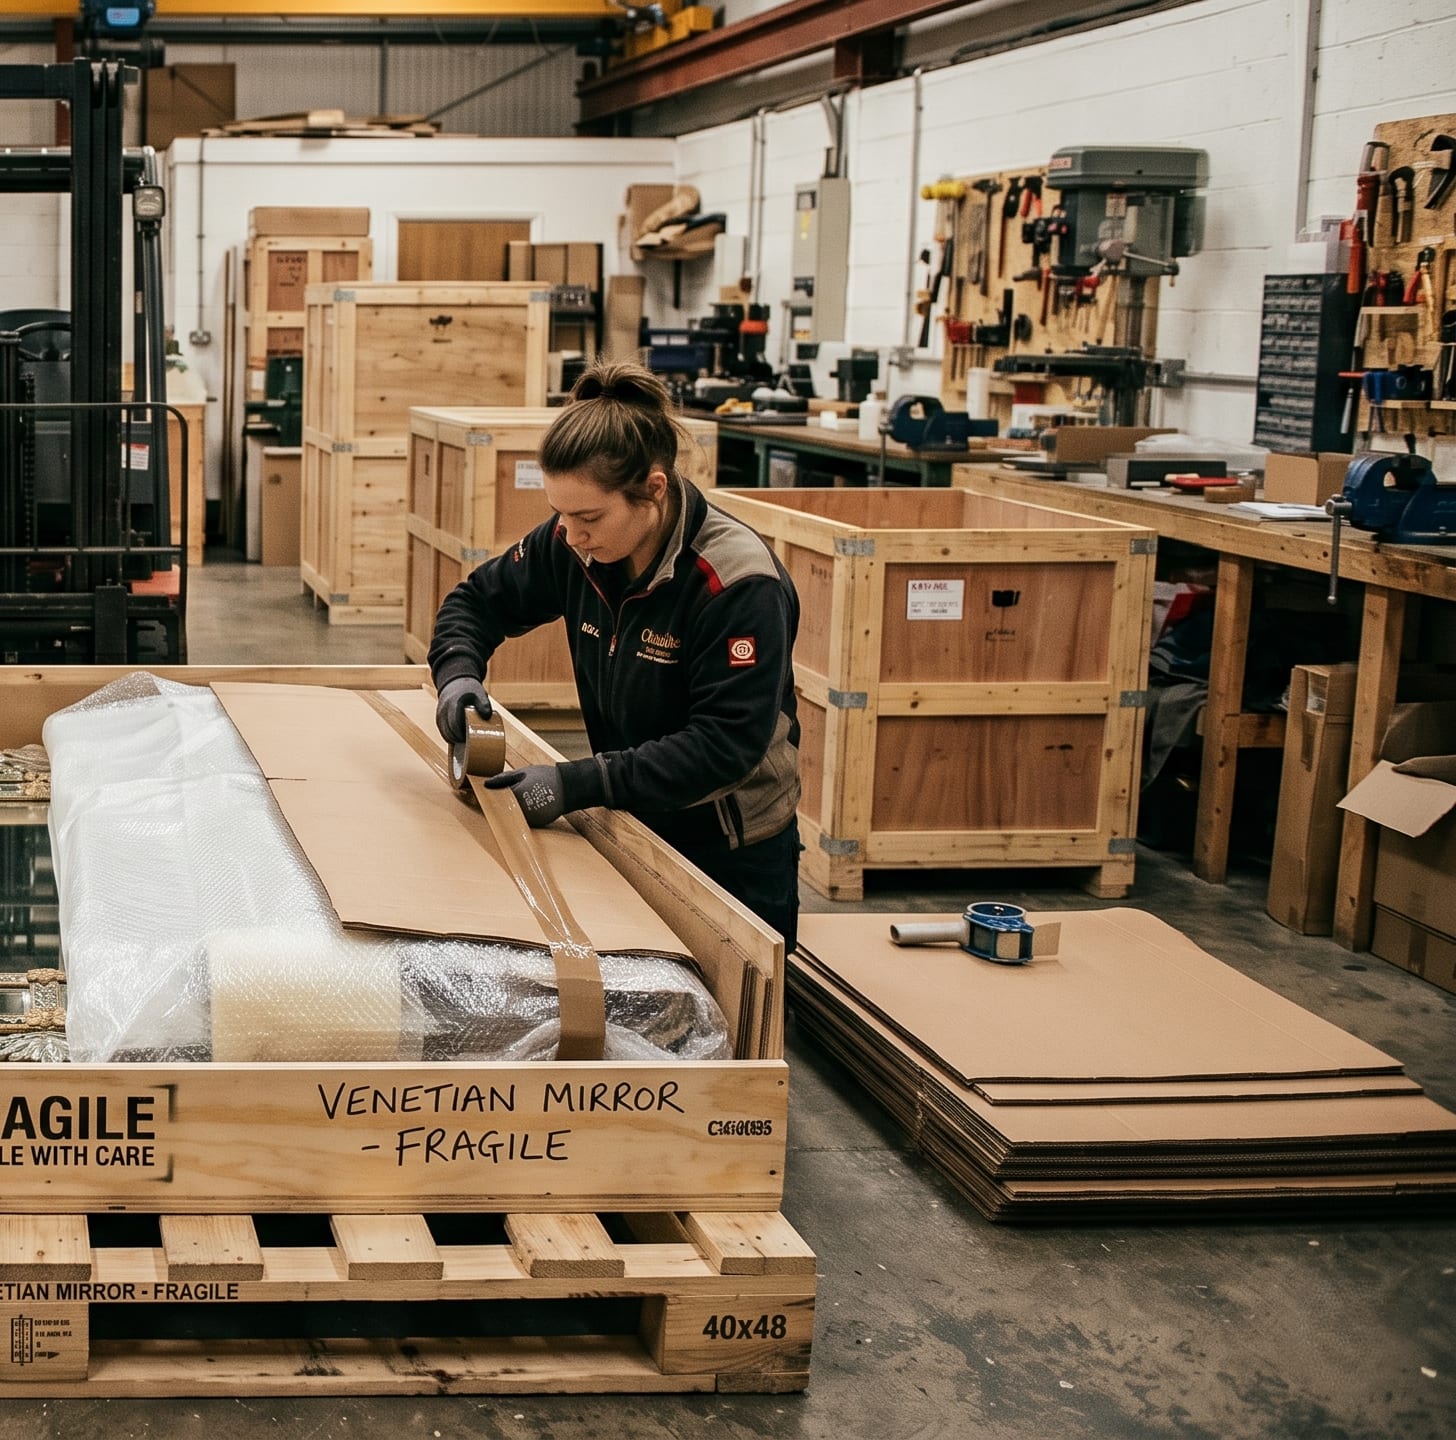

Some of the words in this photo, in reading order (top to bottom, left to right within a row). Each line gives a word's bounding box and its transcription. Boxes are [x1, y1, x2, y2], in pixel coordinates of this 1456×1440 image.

[318, 1082, 515, 1120] VENETIAN
[543, 1081, 685, 1114] MIRROR
[31, 1146, 88, 1166] WITH
[96, 1146, 155, 1166] CARE
[395, 1126, 572, 1166] FRAGILE
[57, 1283, 135, 1300] MIRROR
[154, 1283, 239, 1300] FRAGILE
[703, 1314, 787, 1341] 40x48
